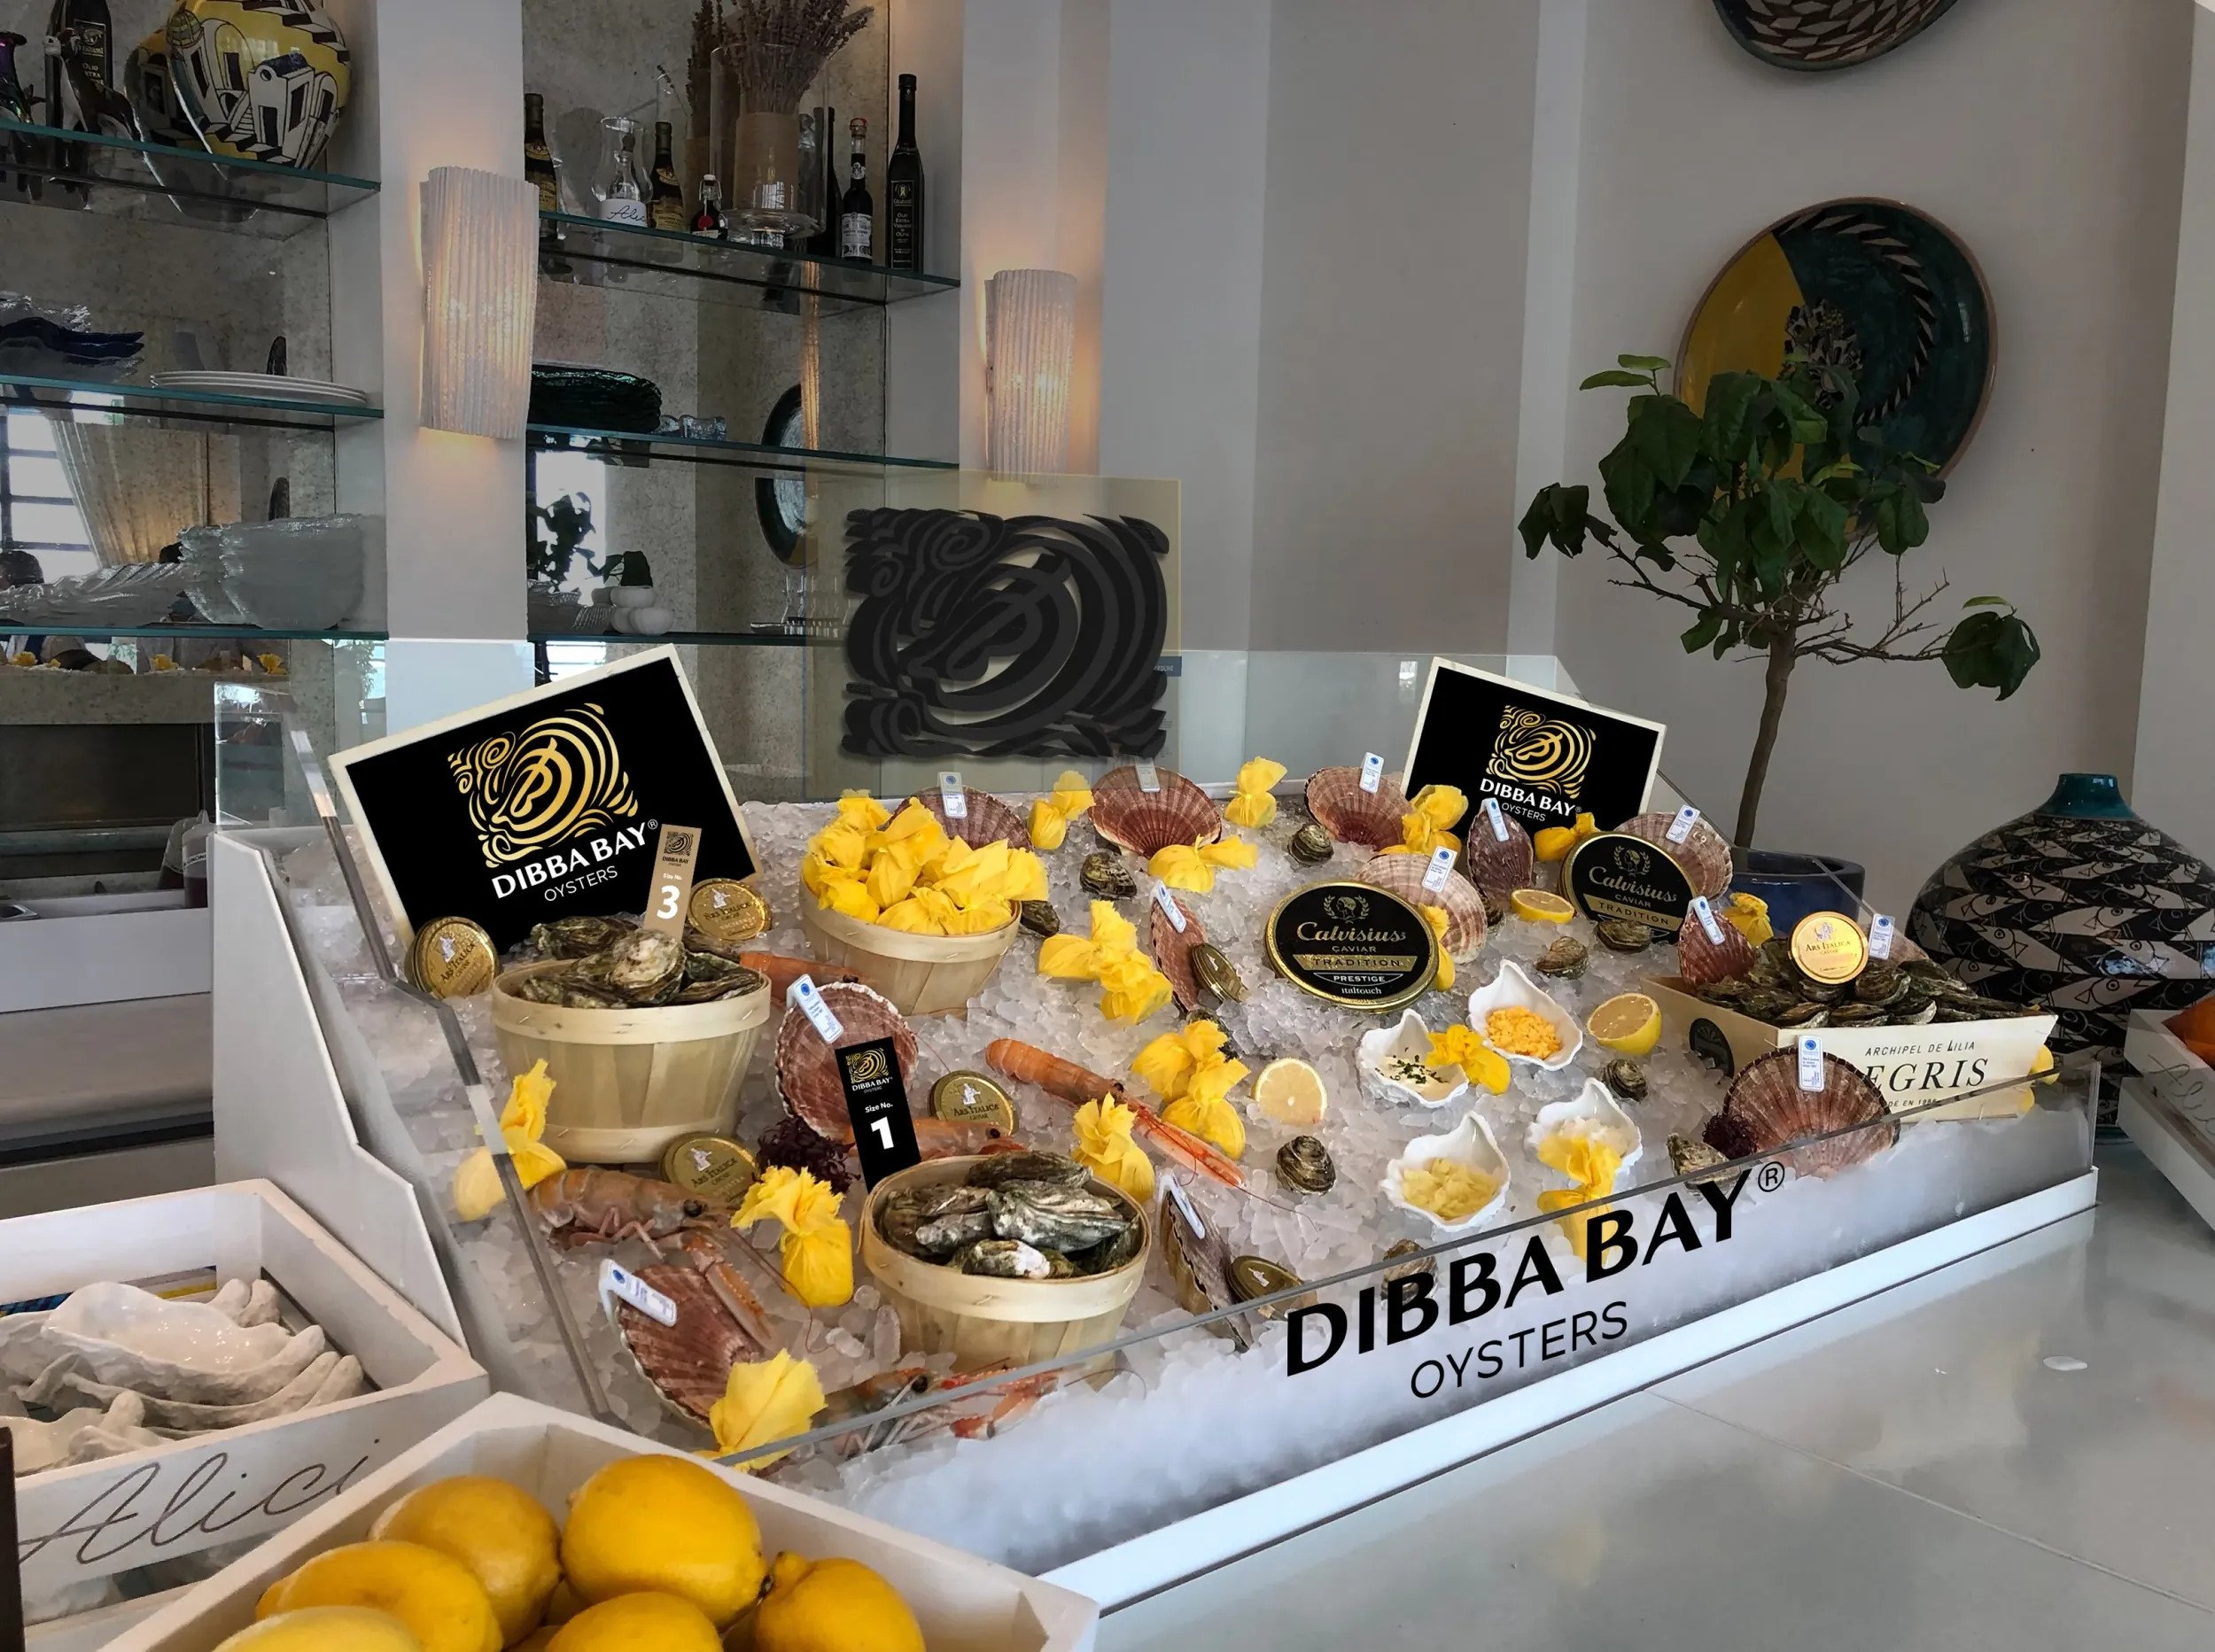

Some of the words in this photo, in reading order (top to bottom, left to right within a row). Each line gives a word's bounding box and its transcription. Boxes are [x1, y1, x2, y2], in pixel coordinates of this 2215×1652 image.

[84, 70, 101, 79] XTRA
[1480, 778, 1536, 807] DIBBA
[1502, 803, 1546, 822] OYSTERS
[492, 848, 590, 899] DIBBA
[544, 865, 618, 902] OYSTERS
[1589, 865, 1677, 903] Calvisius
[657, 885, 680, 919] 3
[1614, 894, 1652, 908] CAVIAR
[1598, 902, 1669, 925] TRADITION
[1296, 921, 1407, 942] Calvisius
[1313, 958, 1401, 967] TRADITION
[1341, 986, 1382, 995] italtouch
[1865, 1044, 1922, 1056] ARCHIPEL
[1928, 1043, 1943, 1053] DE
[851, 1080, 875, 1091] DIBBA
[1865, 1058, 1988, 1092] EGRIS
[865, 1105, 880, 1113] Size
[870, 1116, 895, 1150] 1
[1286, 1235, 1563, 1376] DIBBA
[1411, 1301, 1628, 1399] OYSTERS
